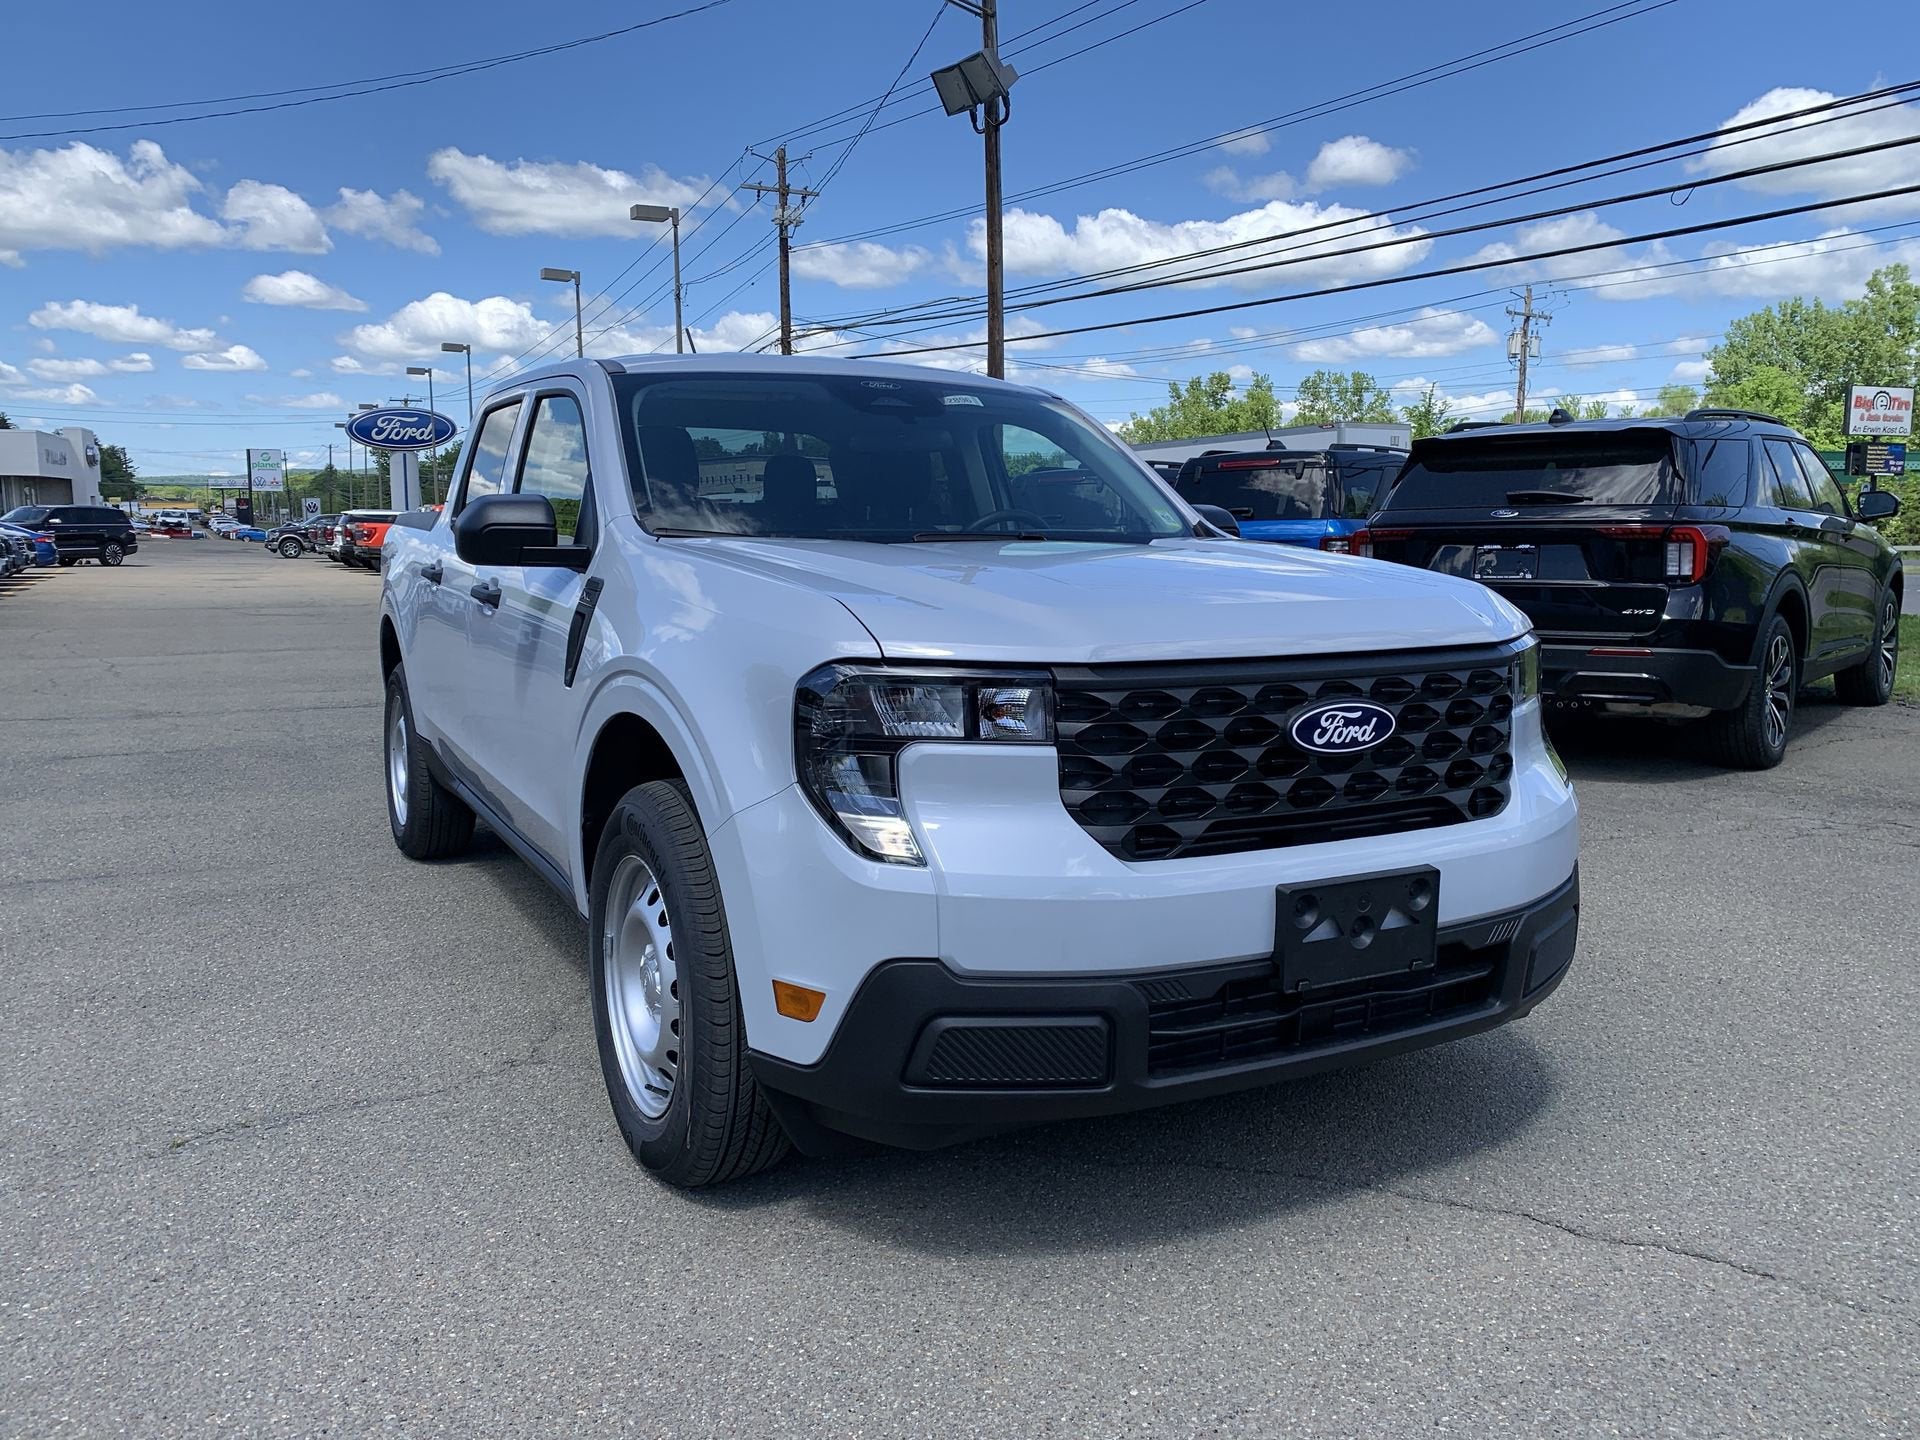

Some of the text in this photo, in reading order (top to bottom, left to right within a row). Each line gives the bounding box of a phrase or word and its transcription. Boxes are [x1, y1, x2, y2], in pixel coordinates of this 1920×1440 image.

[1854, 395, 1873, 412] Big
[1891, 396, 1911, 411] Tire
[371, 415, 433, 441] Ford
[1852, 425, 1861, 433] An
[1862, 425, 1881, 433] Erwin
[1882, 426, 1898, 434] Kost
[252, 461, 281, 470] planet
[1313, 710, 1378, 745] Ford
[627, 813, 666, 883] Continental
